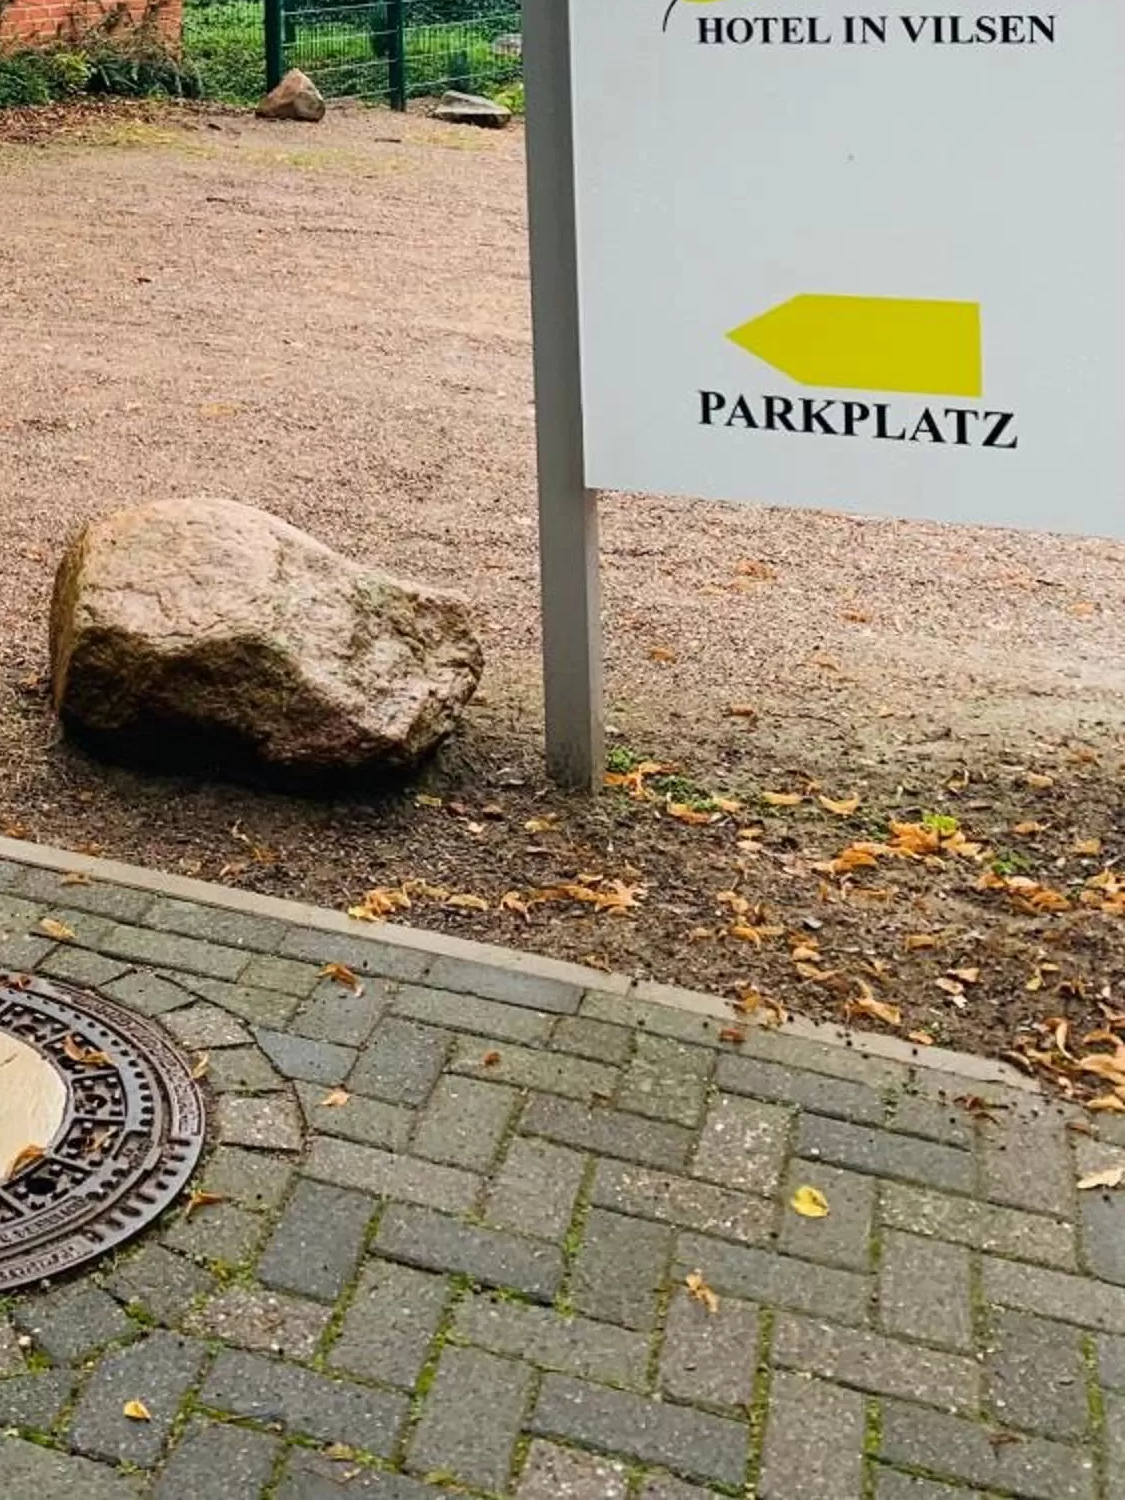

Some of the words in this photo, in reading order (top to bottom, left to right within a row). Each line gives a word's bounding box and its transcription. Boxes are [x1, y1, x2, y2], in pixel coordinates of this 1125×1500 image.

[698, 16, 832, 45] HOTEL
[844, 15, 887, 44] IN
[900, 14, 1055, 44] VILSEN
[699, 391, 1018, 449] PARKPLATZ
